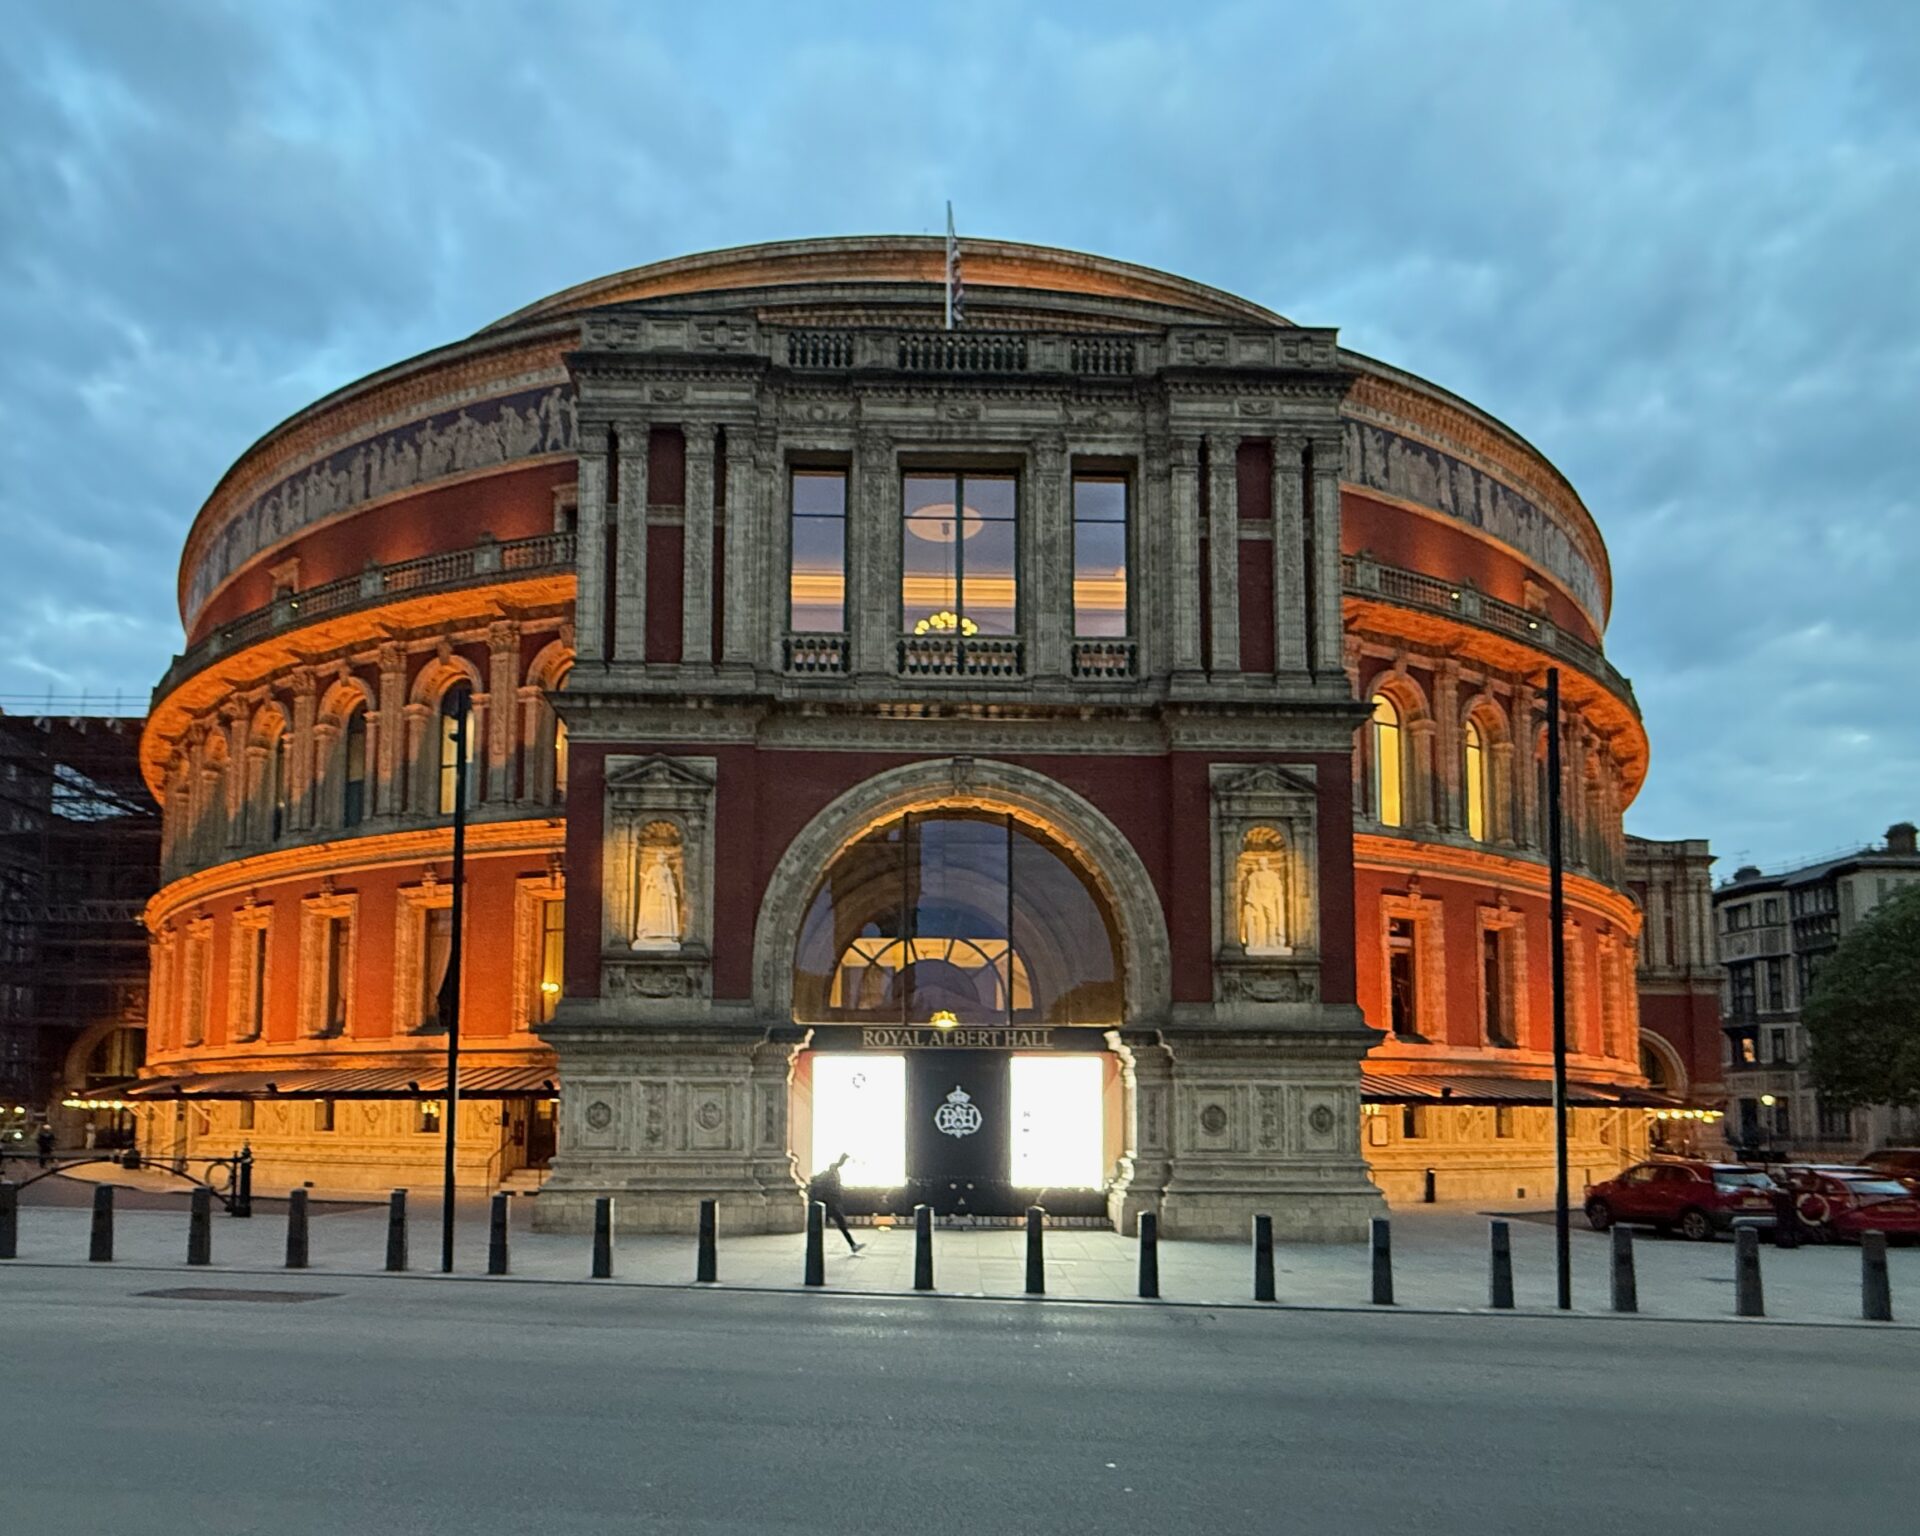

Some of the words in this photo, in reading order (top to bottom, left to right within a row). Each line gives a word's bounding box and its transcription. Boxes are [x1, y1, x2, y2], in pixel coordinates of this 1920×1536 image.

[862, 1030, 924, 1046] ROYAL
[929, 1030, 1000, 1046] ALBERT
[1004, 1030, 1054, 1046] HALL
